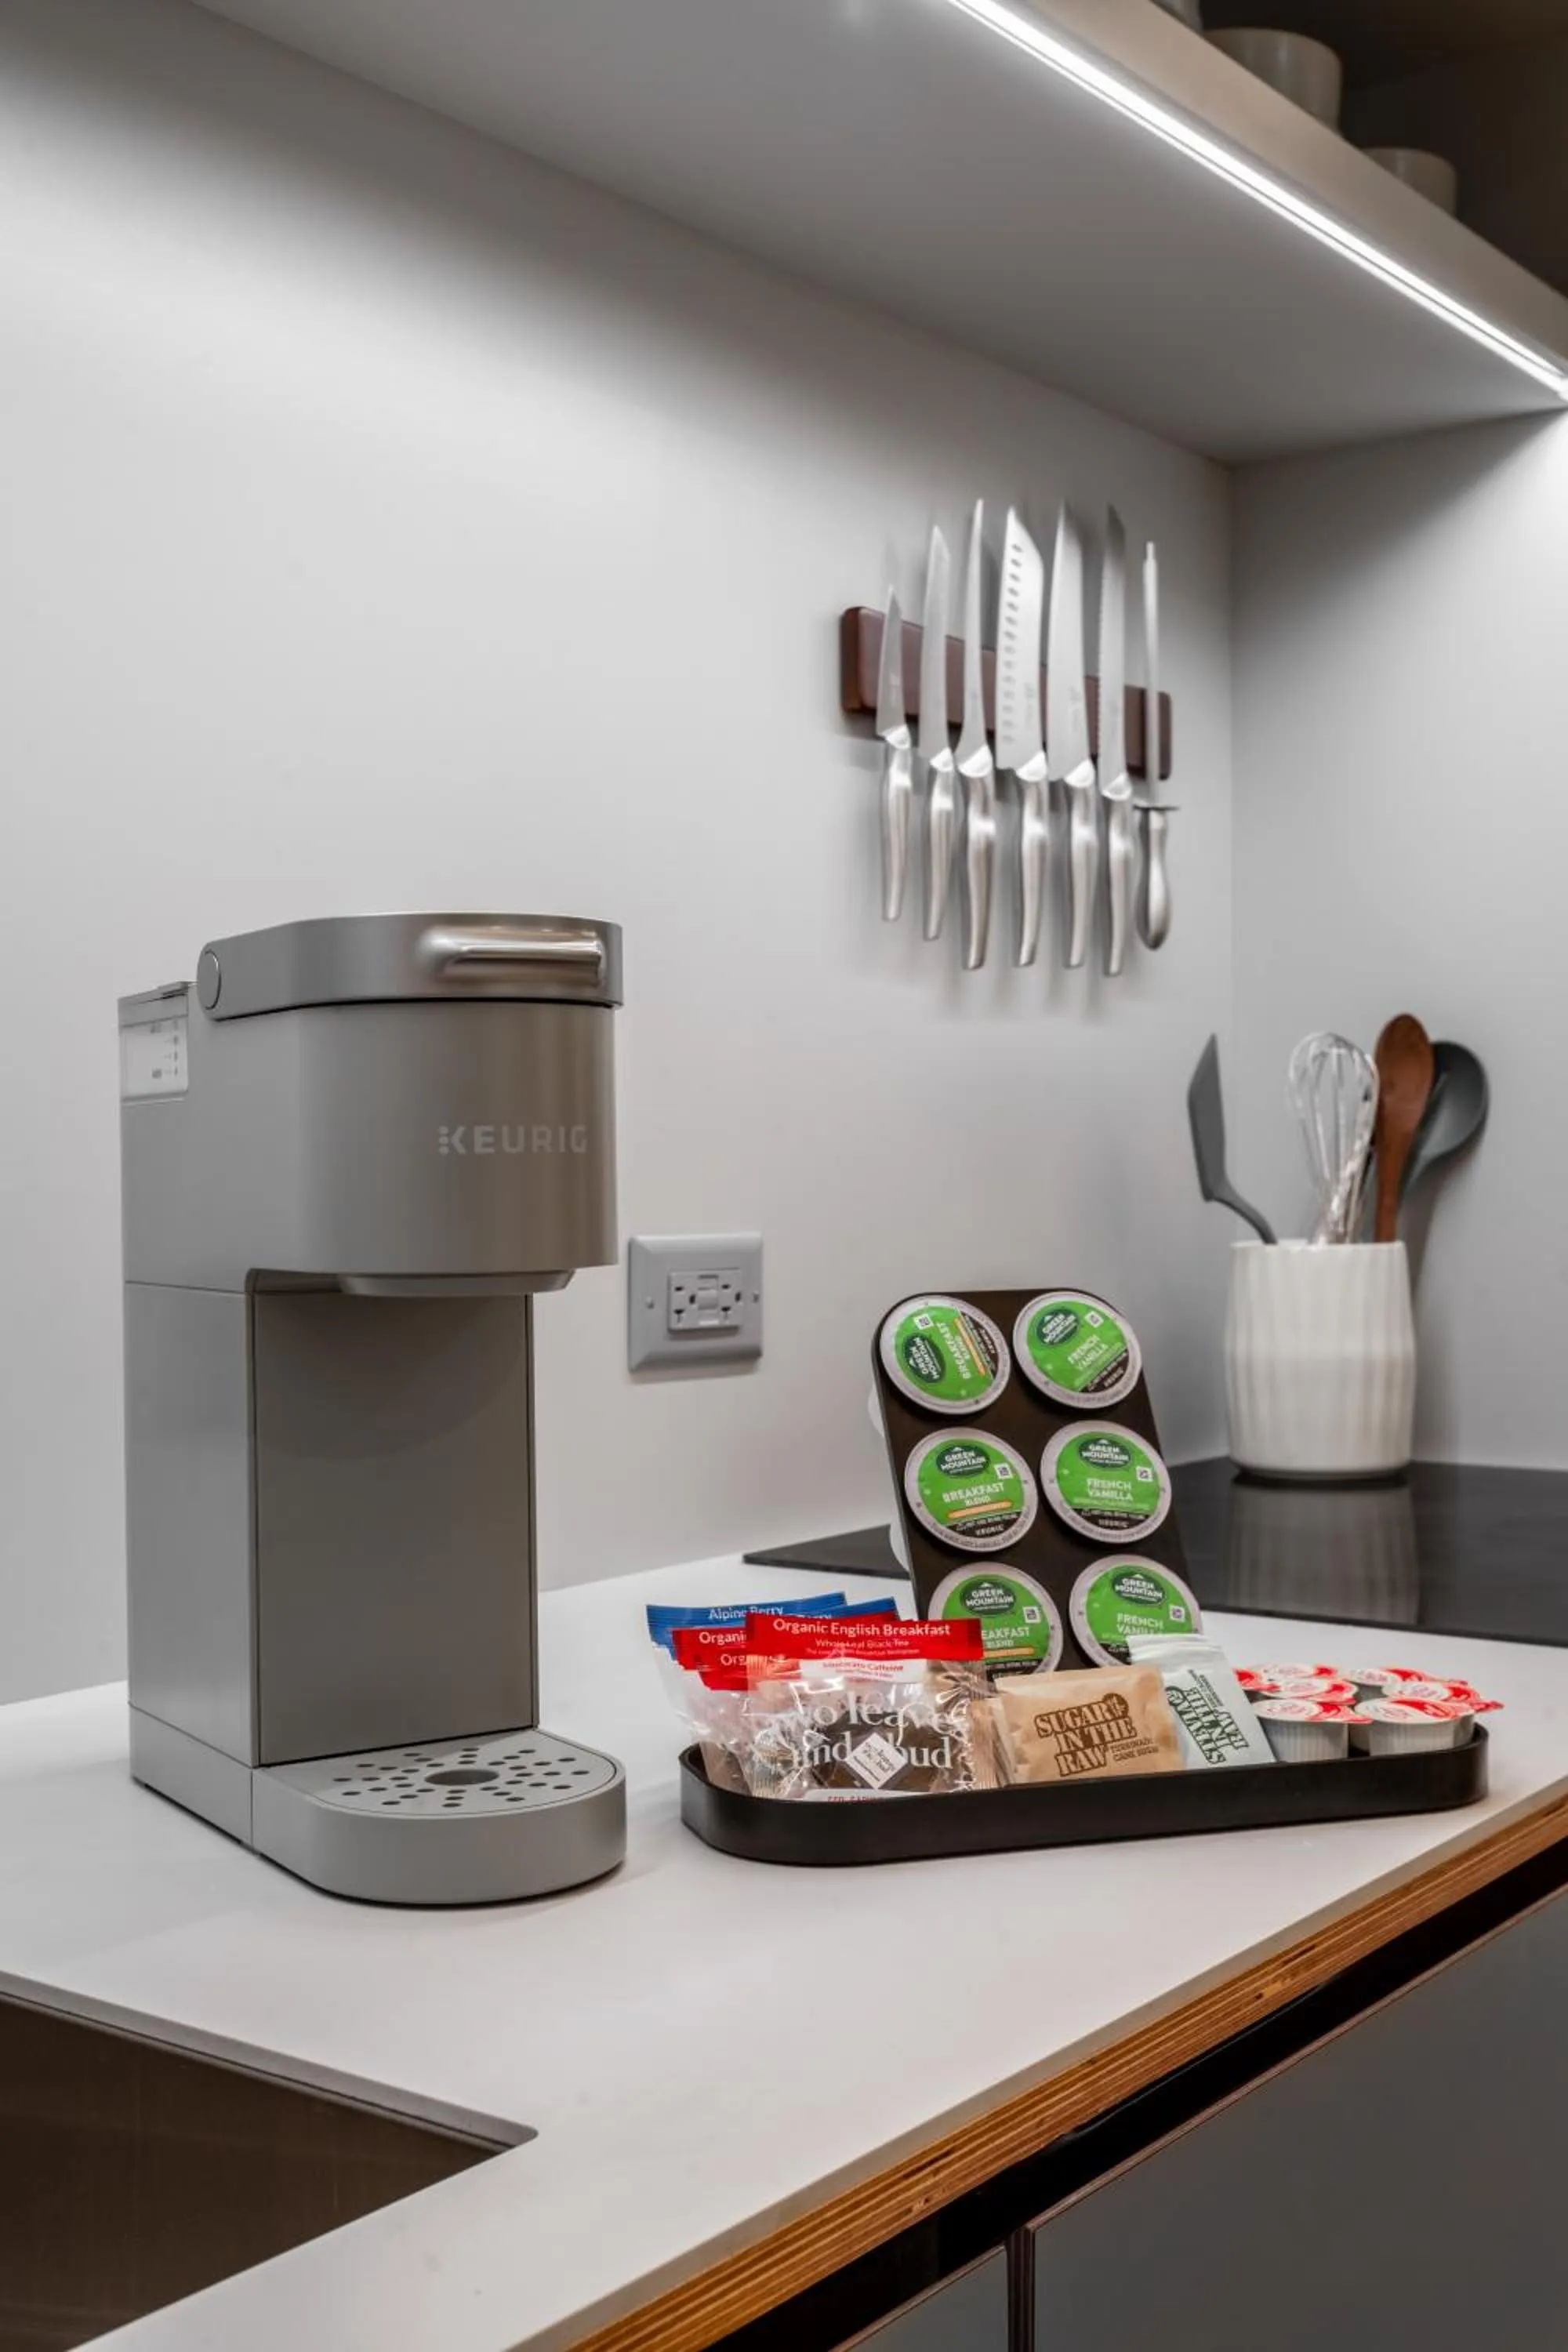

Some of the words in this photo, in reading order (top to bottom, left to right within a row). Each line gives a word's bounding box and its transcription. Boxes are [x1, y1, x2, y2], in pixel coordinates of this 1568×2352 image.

[438, 1125, 587, 1155] KEURIG
[936, 1323, 972, 1380] BREAKFAST
[1088, 1443, 1120, 1453] GREEN
[941, 1456, 986, 1471] MOUNTAIN
[945, 1450, 975, 1462] GREEN
[1081, 1451, 1130, 1461] MOUNTAIN
[1087, 1478, 1131, 1490] FRENCH
[942, 1482, 1005, 1503] BREAKFAST
[1087, 1489, 1133, 1501] VANILLA
[1122, 1577, 1155, 1590] GREEN
[971, 1588, 1004, 1599] GREEN
[1114, 1584, 1163, 1599] MOUNTAIN
[965, 1595, 1014, 1607] MOUNTAIN
[709, 1606, 746, 1621] Alpine
[1116, 1612, 1164, 1629] FRENCH
[772, 1617, 829, 1635] Organic
[831, 1621, 881, 1638] English
[883, 1621, 951, 1636] Breakfast
[982, 1627, 1029, 1640] EAKFAST
[1116, 1624, 1164, 1635] VANILL
[699, 1630, 747, 1646] Organi
[985, 1639, 1014, 1649] BLEND
[1035, 1701, 1113, 1737] SUGAR
[1055, 1729, 1085, 1753] IN
[1084, 1717, 1137, 1746] THE
[1178, 1700, 1226, 1766] STEVIA
[1212, 1704, 1250, 1751] RAW
[1055, 1745, 1108, 1775] RAW
